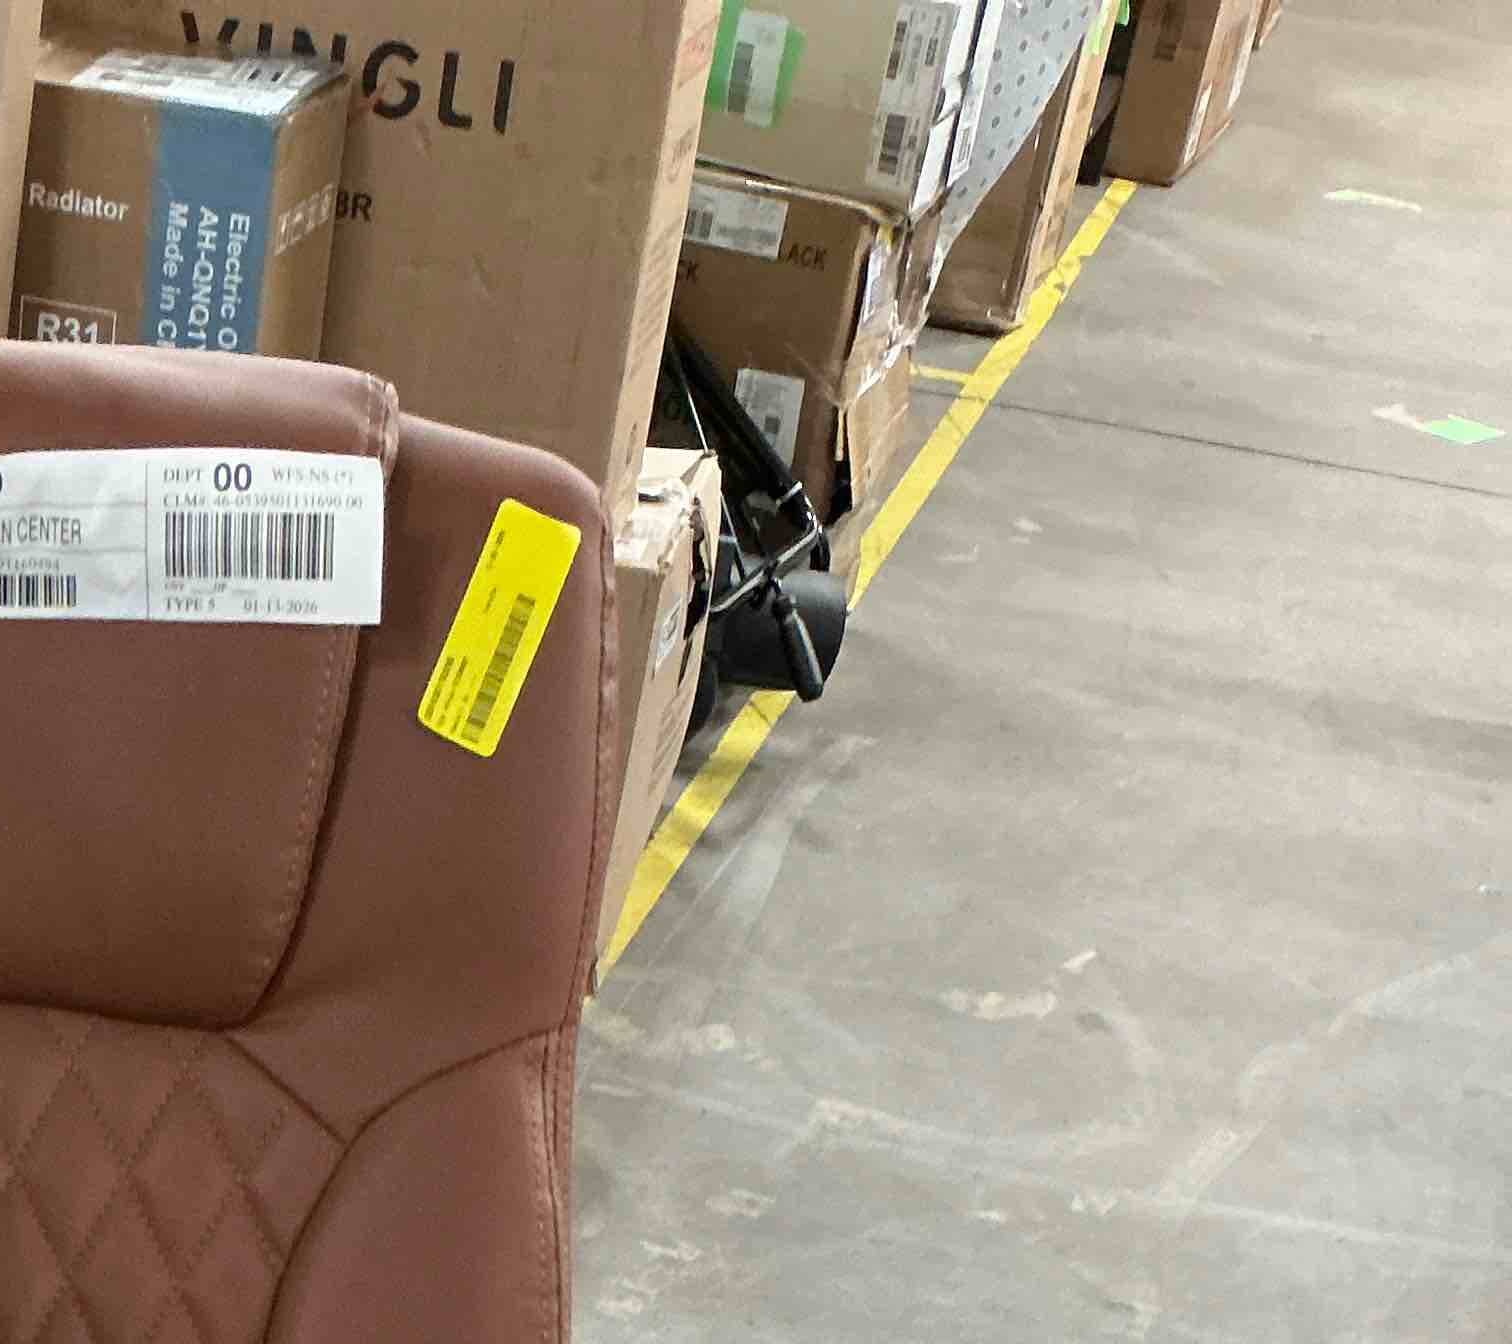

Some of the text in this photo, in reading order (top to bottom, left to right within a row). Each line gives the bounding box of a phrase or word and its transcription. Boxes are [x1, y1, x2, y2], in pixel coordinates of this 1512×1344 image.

[29, 183, 130, 222] Radiator
[163, 202, 189, 278] Made
[188, 205, 219, 350] AH-QNQ1
[220, 212, 251, 320] Electric
[159, 283, 180, 311] in
[213, 462, 253, 492] 00
[16, 516, 83, 544] CENTER
